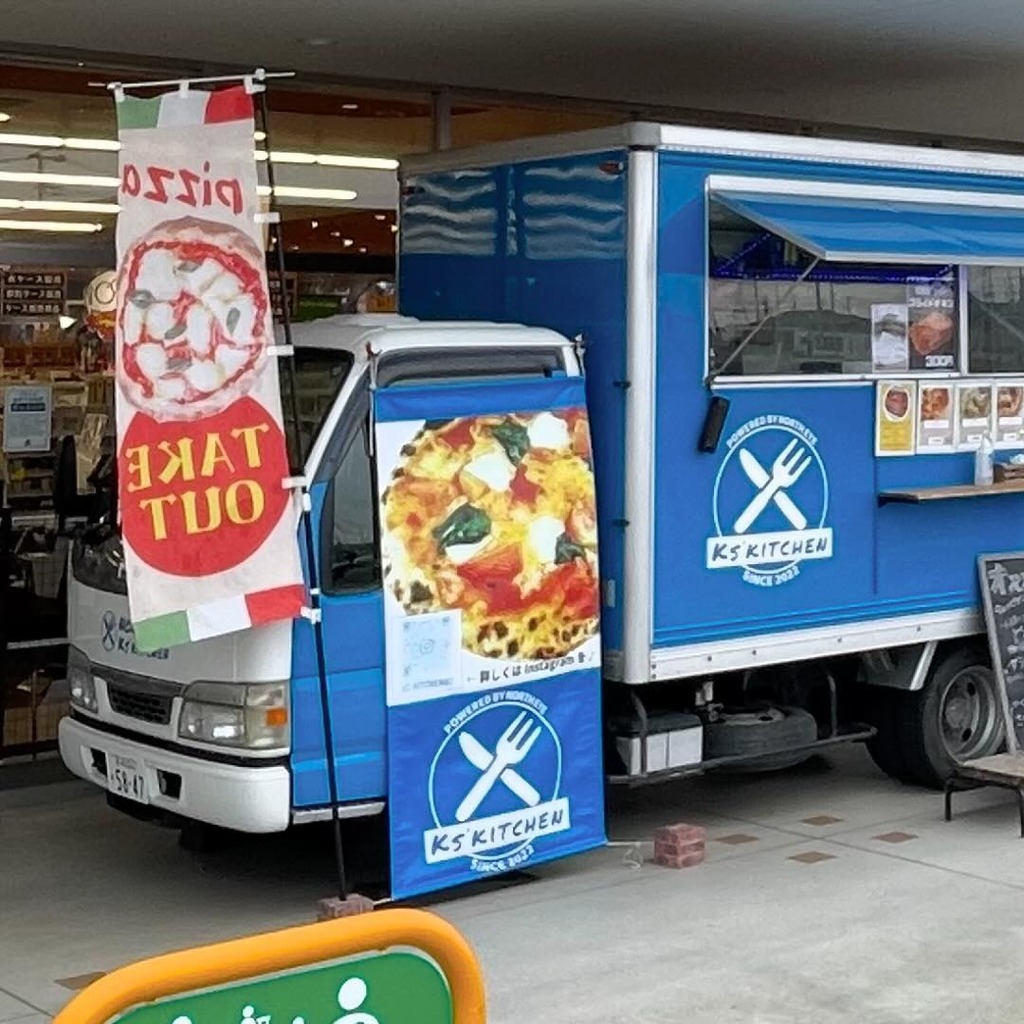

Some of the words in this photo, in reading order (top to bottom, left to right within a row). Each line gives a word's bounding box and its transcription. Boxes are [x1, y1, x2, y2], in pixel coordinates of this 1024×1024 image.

[726, 416, 766, 449] POWERED
[742, 570, 773, 588] SINCE
[524, 656, 575, 674] Instagram
[443, 694, 492, 735] POWERED
